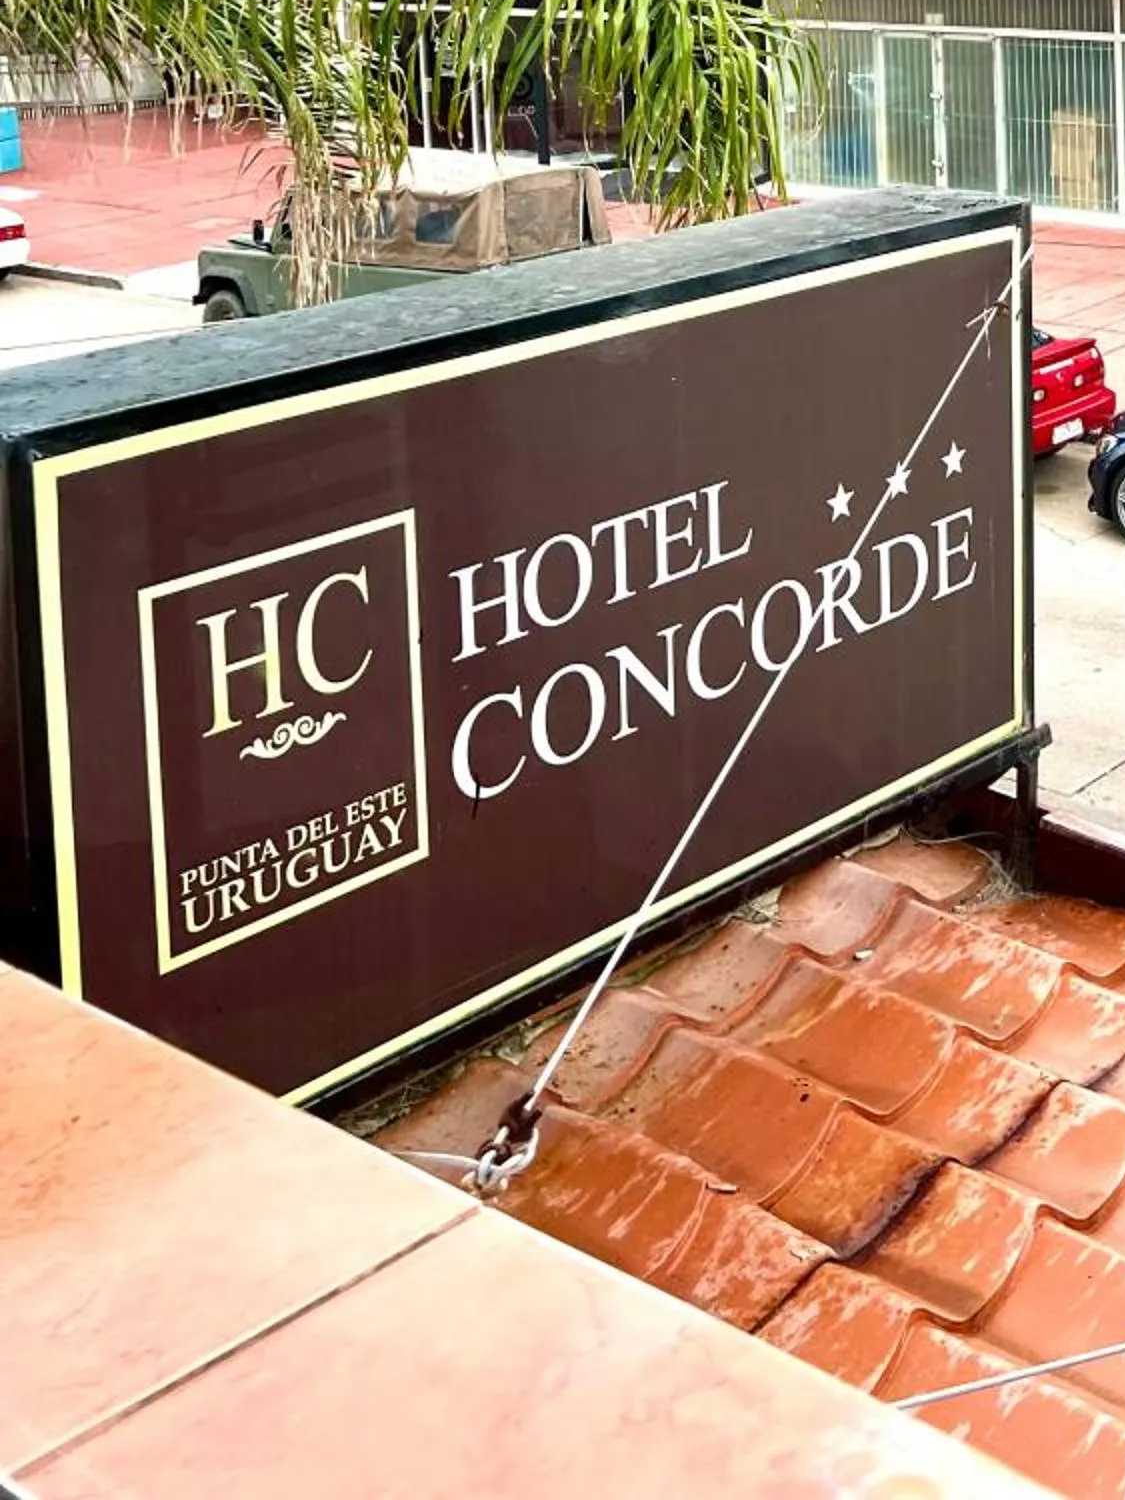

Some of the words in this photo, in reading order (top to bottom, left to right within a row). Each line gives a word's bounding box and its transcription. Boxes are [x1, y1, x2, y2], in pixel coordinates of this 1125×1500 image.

[196, 565, 373, 738] HC
[448, 480, 753, 662] HOTEL
[451, 507, 977, 800] CONCORDE
[180, 838, 280, 896] PUNTA
[286, 812, 339, 851] DEL
[345, 782, 407, 827] ESTE
[181, 808, 407, 933] URUGUAY
